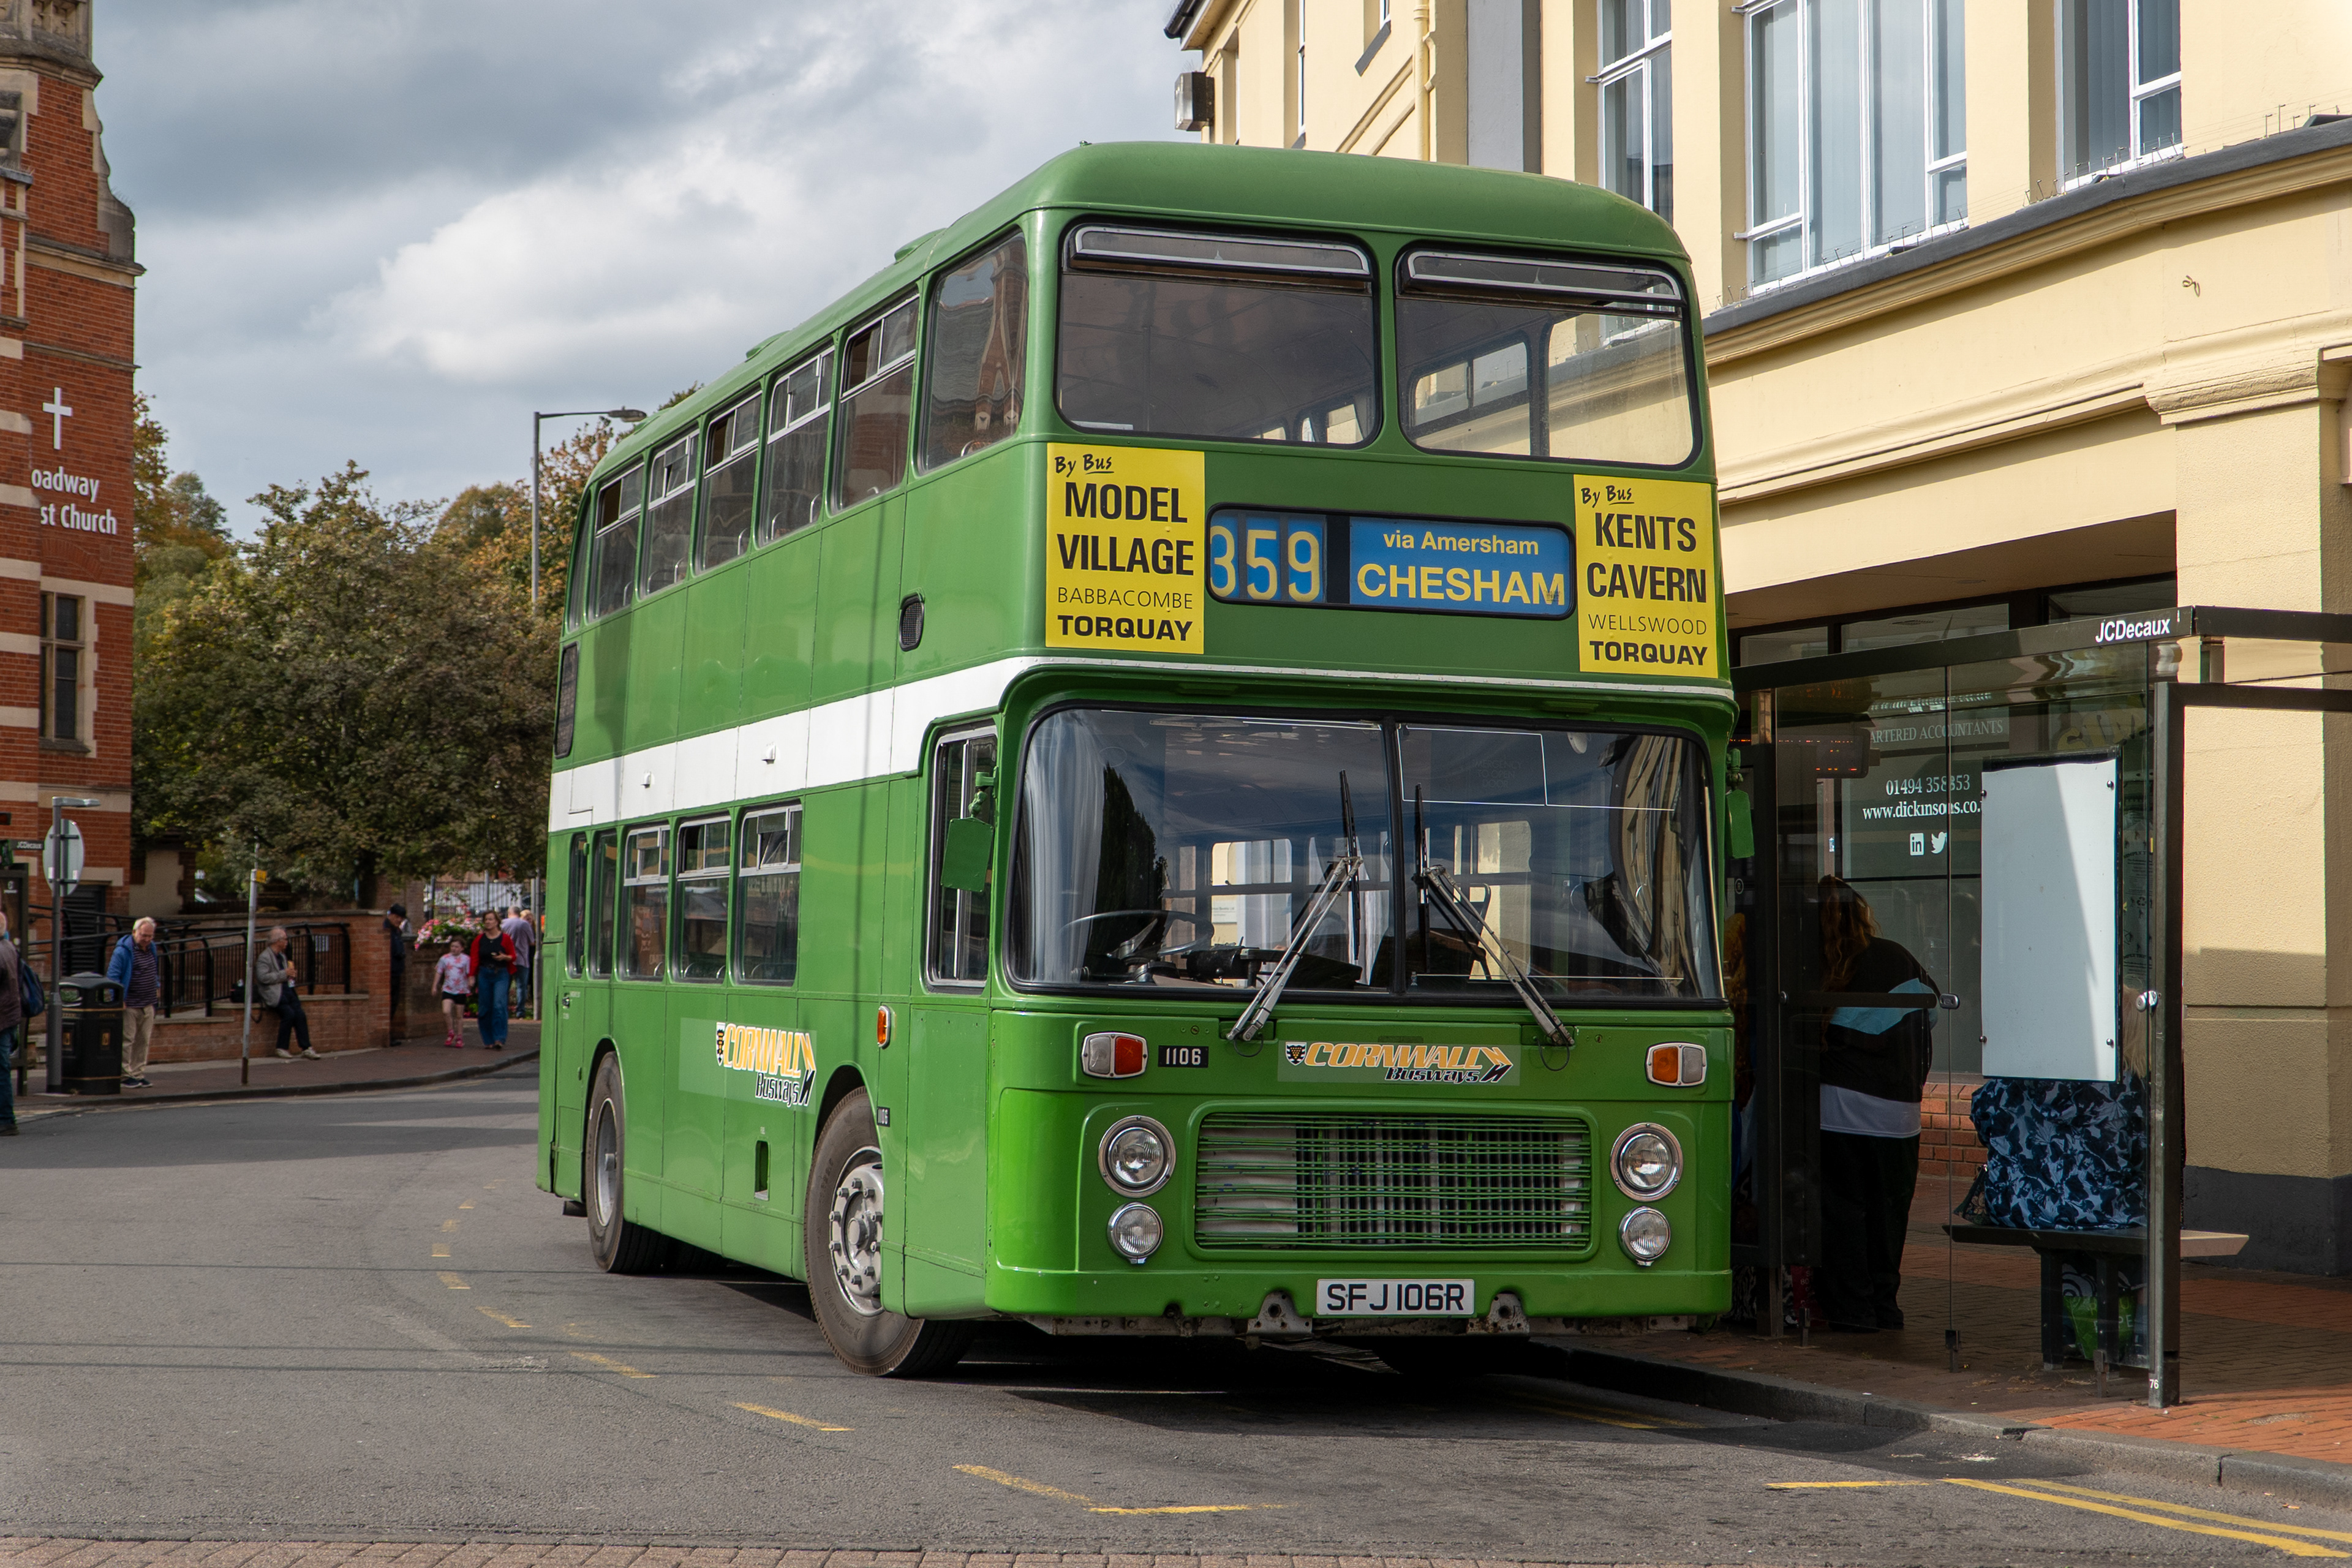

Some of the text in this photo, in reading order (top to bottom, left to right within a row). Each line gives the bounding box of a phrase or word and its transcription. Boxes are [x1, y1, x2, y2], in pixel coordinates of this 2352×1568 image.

[1055, 454, 1113, 477] By Bus
[1065, 481, 1188, 523] MODEL
[1581, 485, 1633, 508] By Bus
[40, 503, 117, 535] st Church
[1383, 530, 1539, 556] via Amersham
[1595, 512, 1697, 552] KENTS
[1057, 533, 1194, 576] VILLAGE
[1210, 526, 1320, 601] 359
[1357, 563, 1565, 606] CHESHAM
[1587, 562, 1706, 603] CAVERN
[1058, 587, 1193, 609] BABBACOMBE
[1057, 615, 1193, 641] TORQUAY
[1588, 614, 1707, 635] WELLSWOOD
[2095, 618, 2171, 643] JCDecaux
[1589, 641, 1708, 666] TORQUAY
[1919, 719, 2003, 740] ACCOUNTANTS
[1886, 778, 1922, 796] 01494
[1863, 799, 1982, 820] www.dickinsons.co.
[723, 1023, 802, 1077] CORNWALL
[1165, 1048, 1202, 1066] 1106
[1305, 1042, 1484, 1070] CORNWALL
[1384, 1066, 1480, 1084] Busways
[2149, 1379, 2159, 1390] 76
